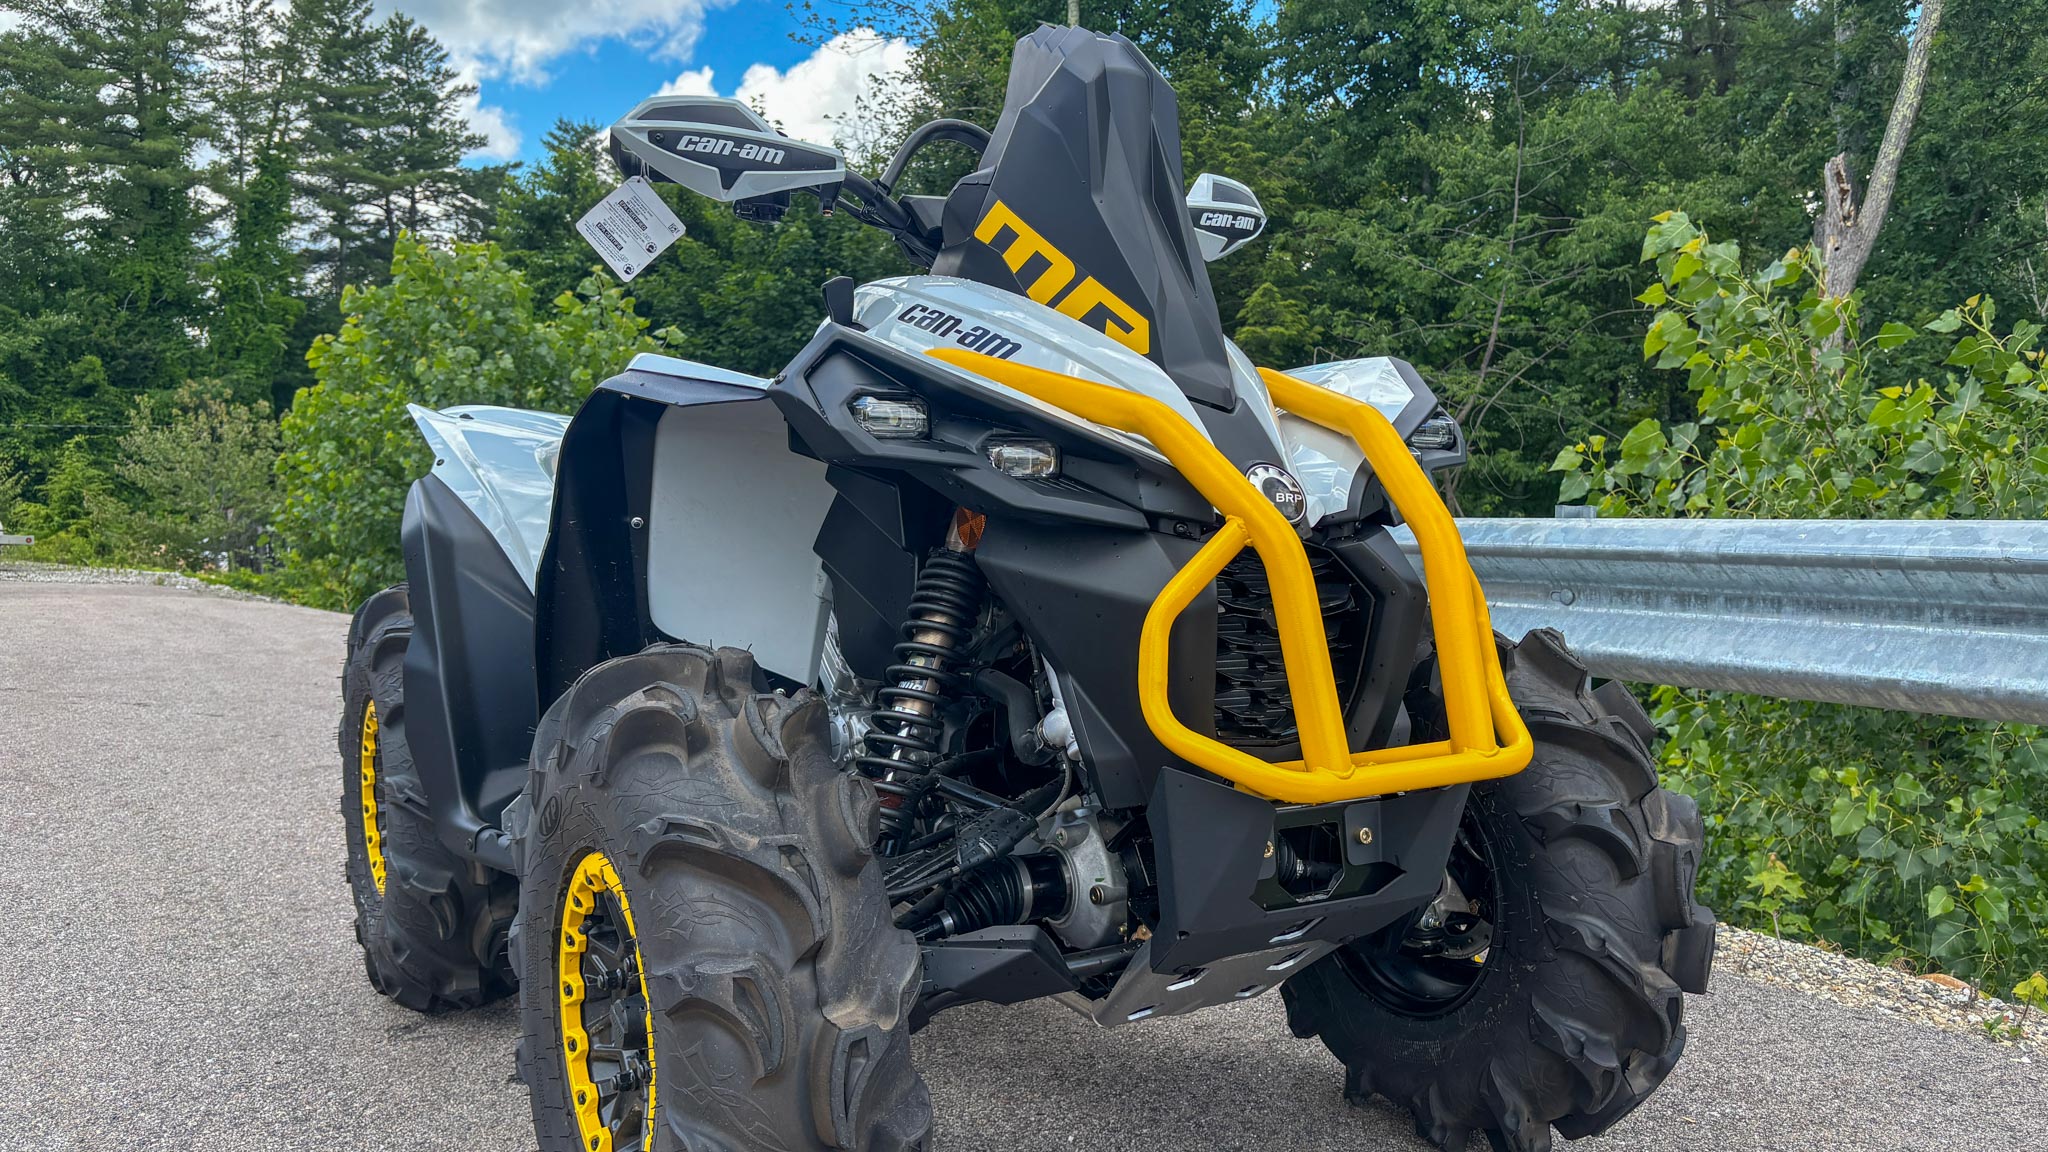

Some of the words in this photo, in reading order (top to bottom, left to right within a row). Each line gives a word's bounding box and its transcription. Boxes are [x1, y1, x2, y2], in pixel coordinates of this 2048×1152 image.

[676, 135, 785, 164] can-am
[1200, 212, 1255, 230] can-am
[897, 304, 1022, 360] can-am
[1276, 493, 1302, 502] BRP
